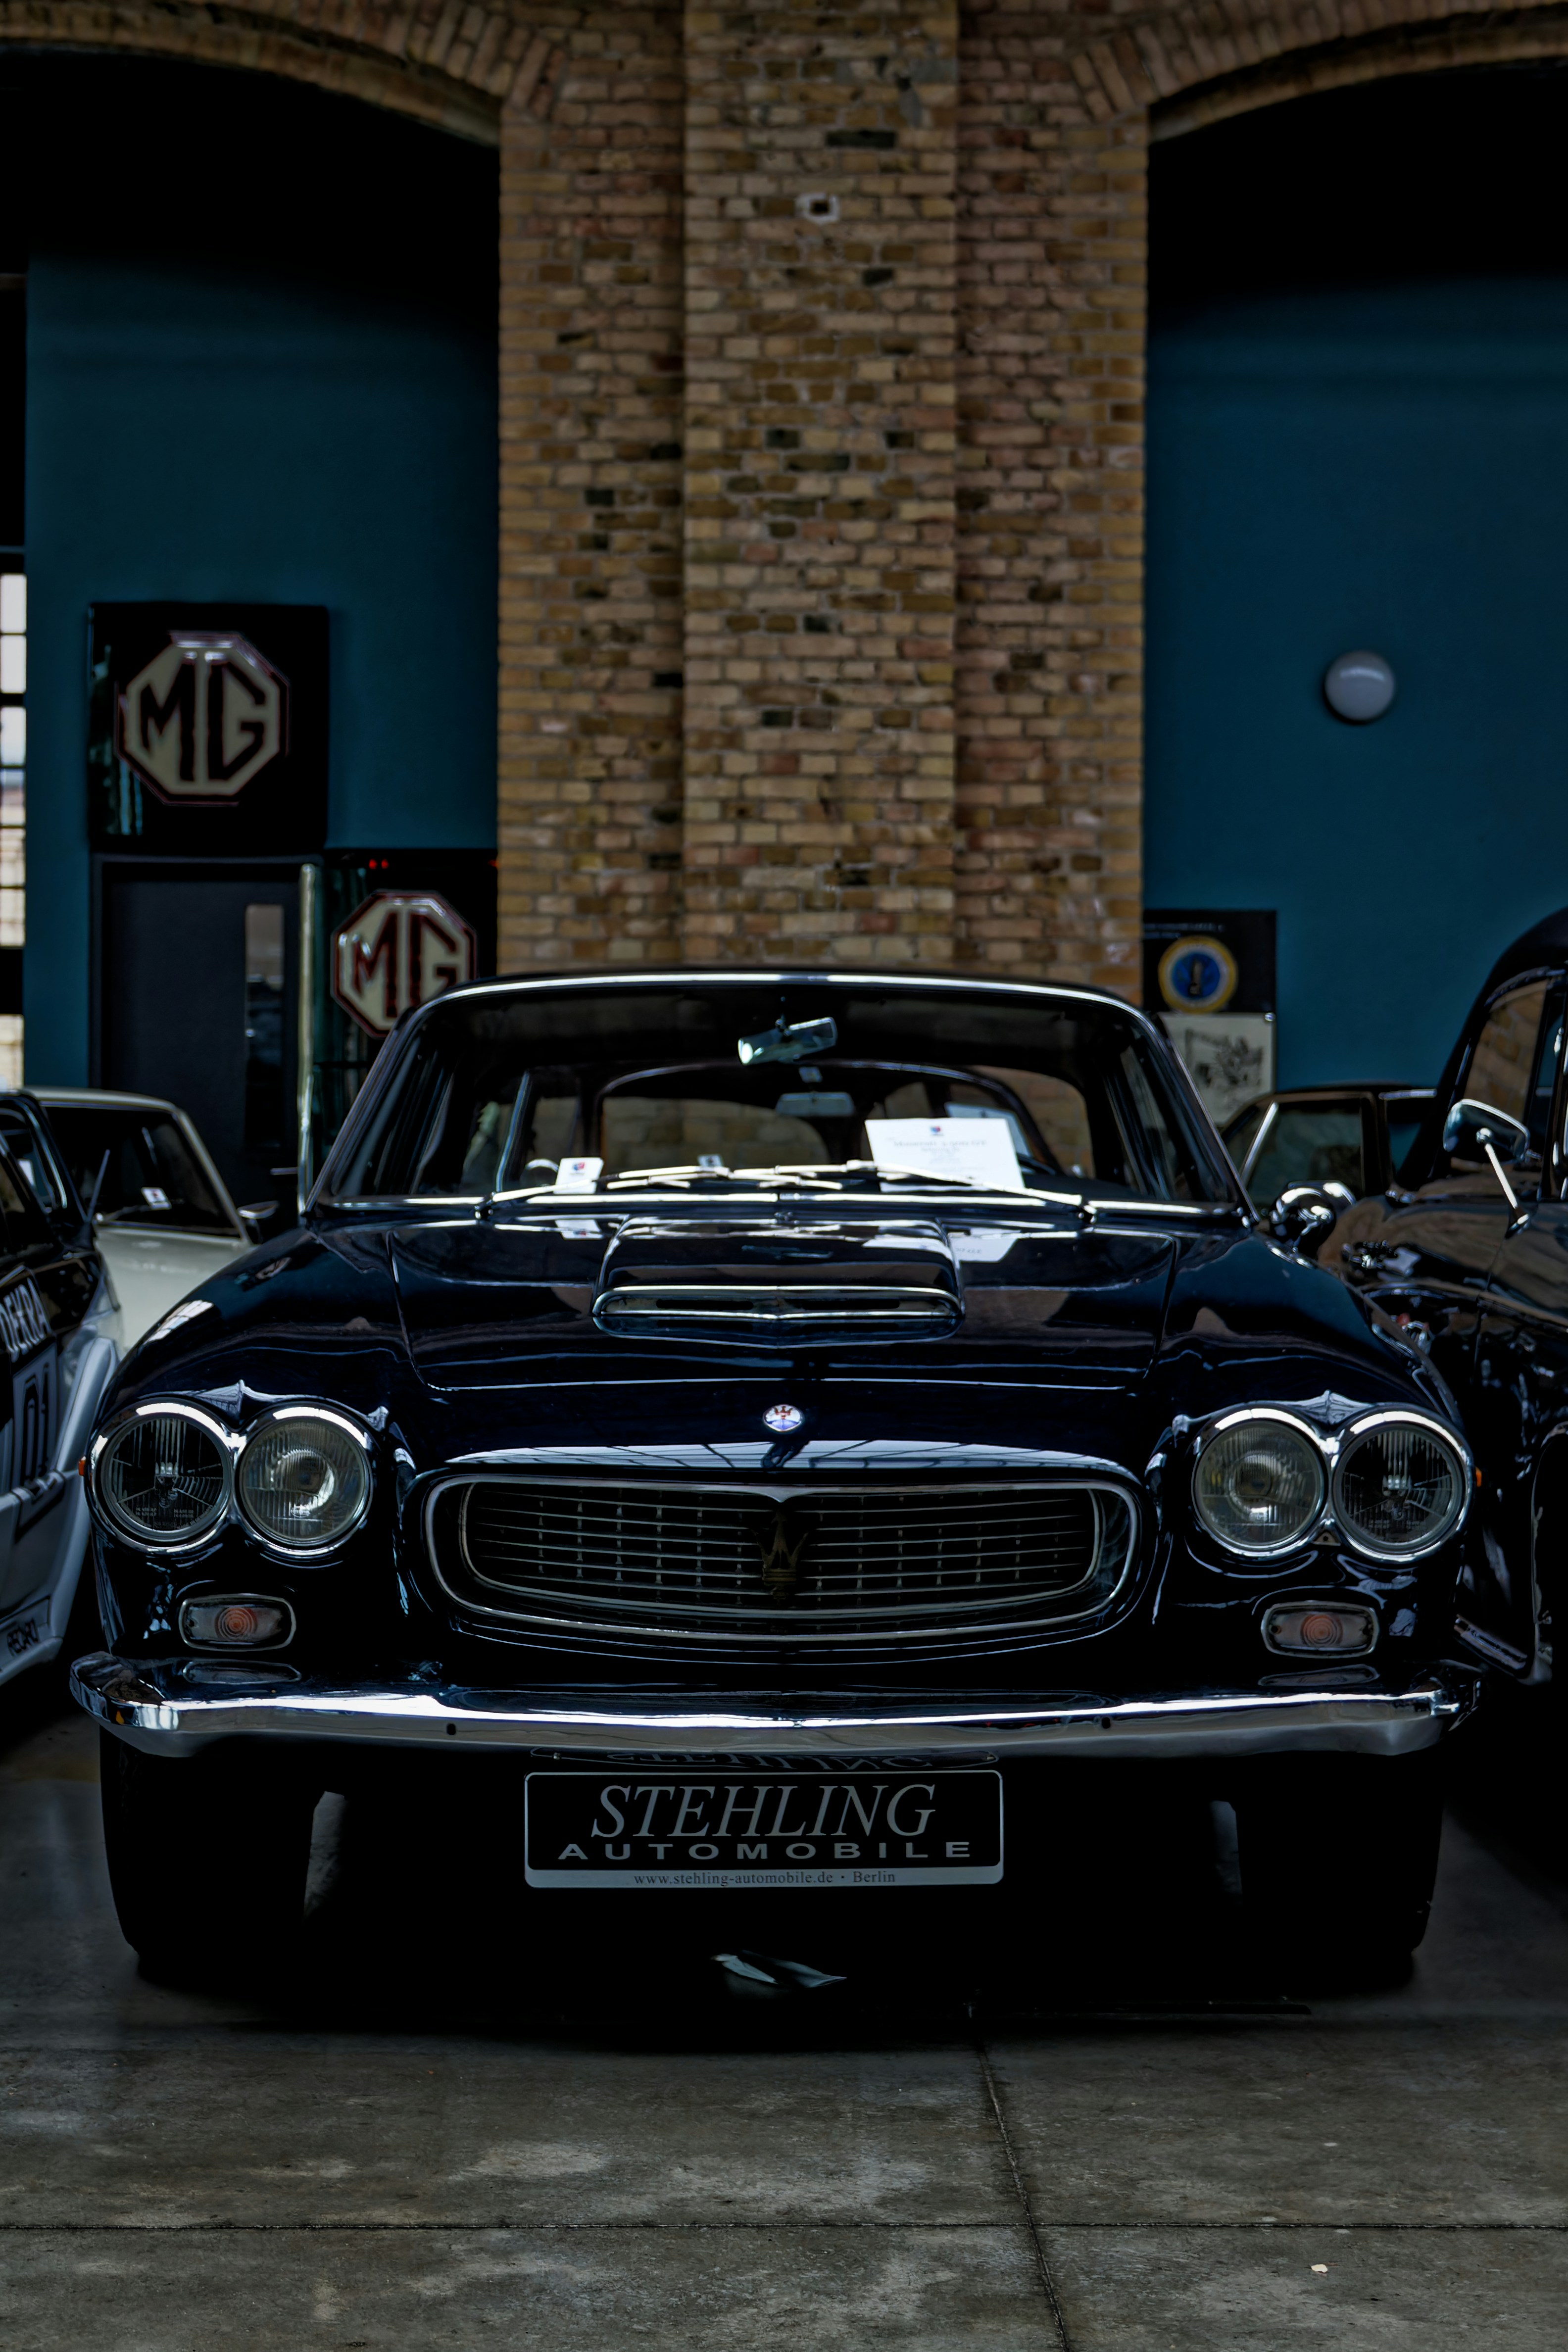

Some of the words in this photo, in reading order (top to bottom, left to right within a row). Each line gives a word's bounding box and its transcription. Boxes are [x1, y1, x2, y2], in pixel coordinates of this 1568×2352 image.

[141, 662, 266, 782] MG
[355, 912, 457, 1018] MG
[591, 1785, 935, 1838] STEHLING
[557, 1842, 971, 1860] AUTOMOBILE
[634, 1871, 833, 1886] www.stehling-automobile.de
[852, 1871, 895, 1883] Berlin
